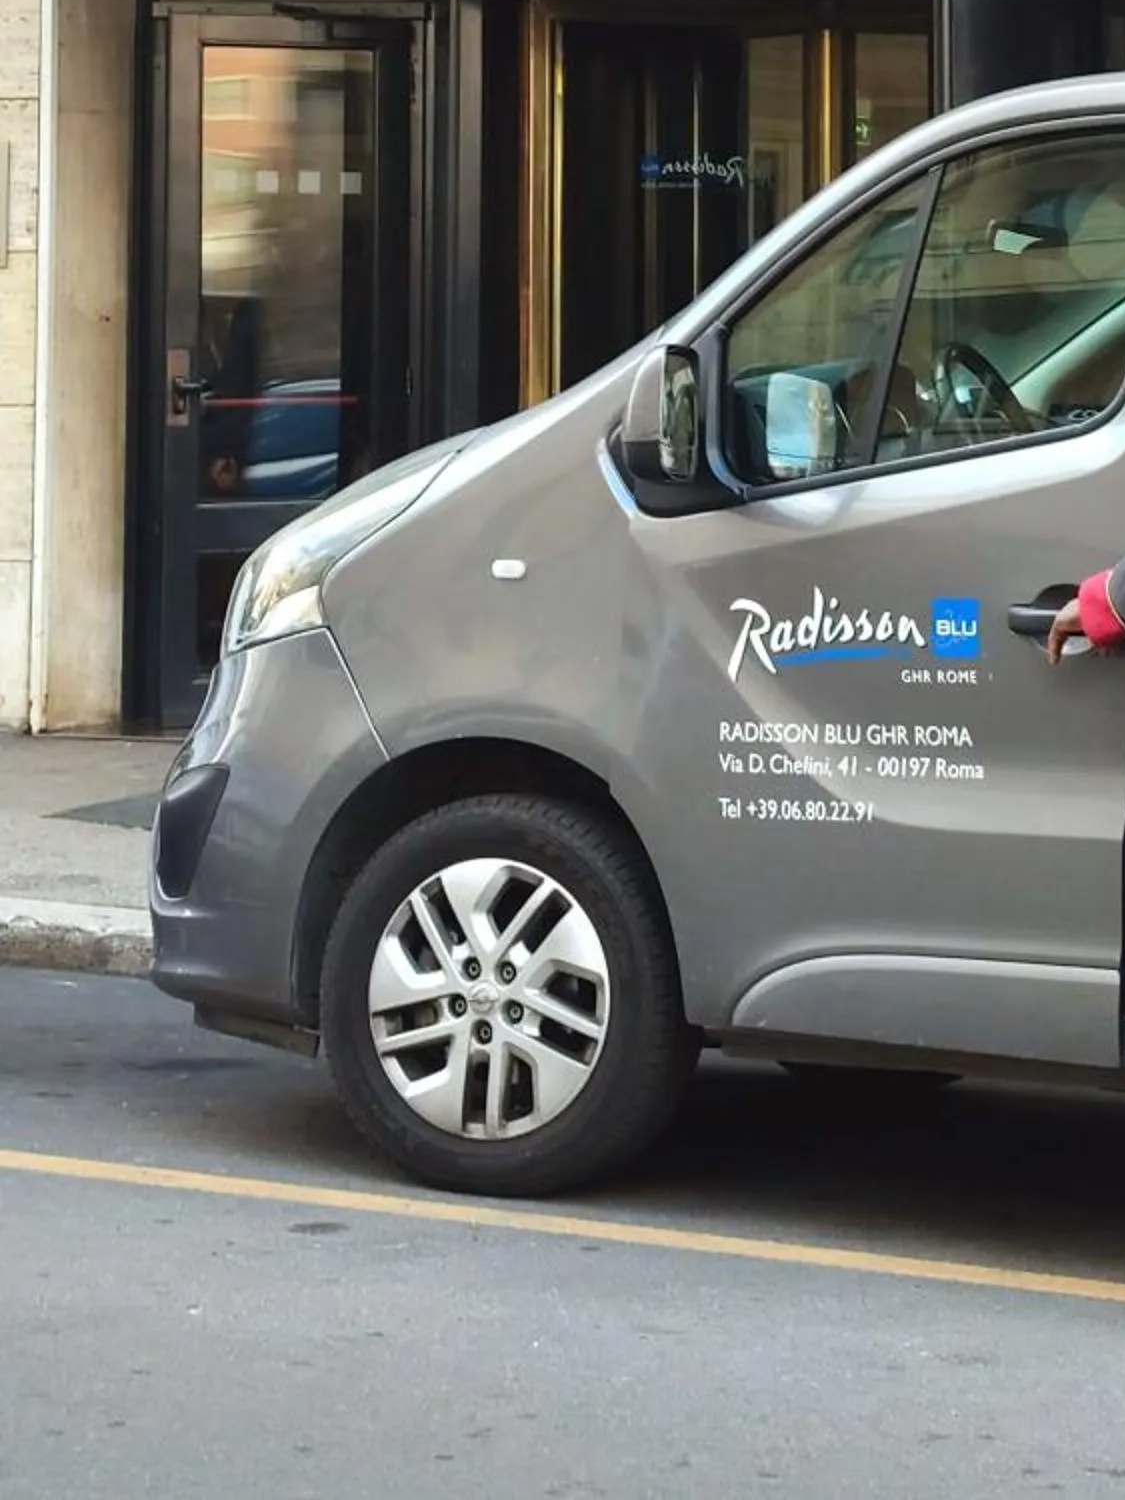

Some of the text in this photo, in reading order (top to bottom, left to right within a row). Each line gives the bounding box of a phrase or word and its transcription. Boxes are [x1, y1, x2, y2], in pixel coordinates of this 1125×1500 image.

[727, 586, 977, 683] Radisson BLU
[901, 670, 977, 684] GHR ROME
[719, 721, 973, 747] RADISSON BLU GHR ROMA
[719, 753, 743, 773] Via
[748, 756, 766, 773] D.
[837, 757, 858, 776] 41
[877, 757, 930, 777] 00197
[935, 759, 985, 780] Roma
[718, 798, 875, 821] Tel +39.06.80.22.91
